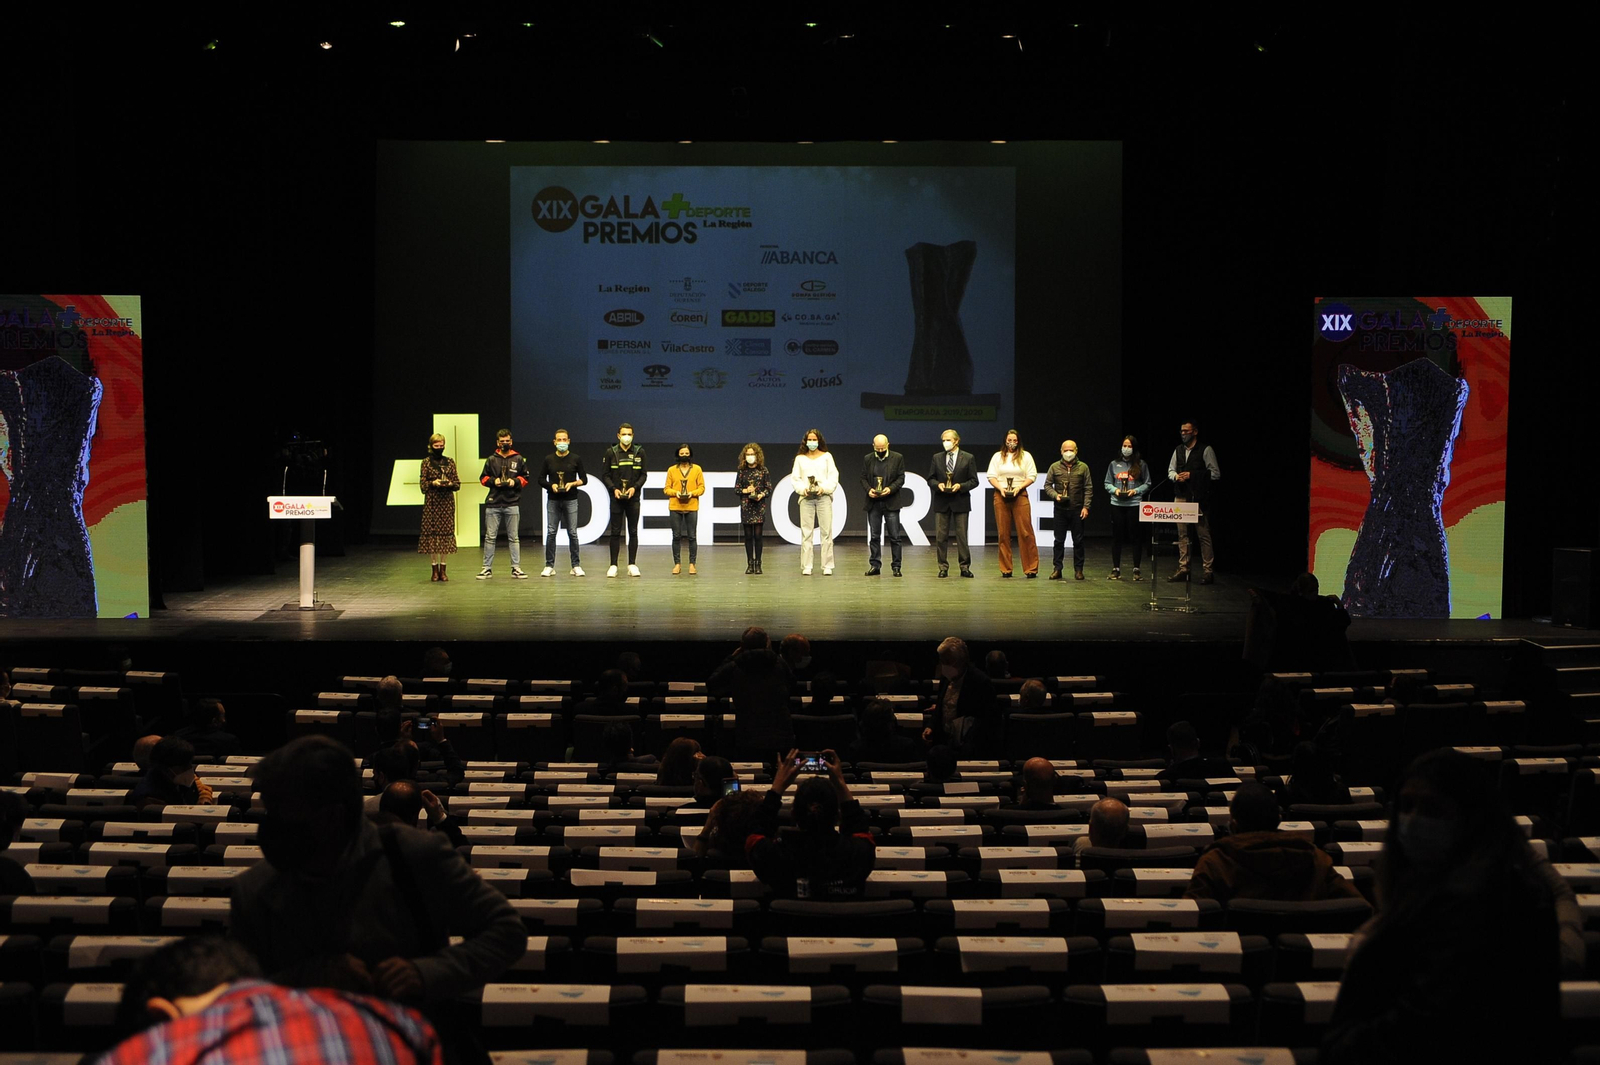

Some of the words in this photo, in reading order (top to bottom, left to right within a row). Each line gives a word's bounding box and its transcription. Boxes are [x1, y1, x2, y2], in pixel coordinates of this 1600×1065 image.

[537, 200, 573, 219] XIX
[580, 195, 661, 219] GALA
[687, 207, 751, 218] DEPORTE
[703, 220, 716, 228] La
[583, 222, 697, 244] PREMIOS
[599, 284, 612, 293] La
[608, 313, 640, 323] ABRIL
[725, 311, 774, 324] GADIS
[1321, 314, 1353, 331] XIX
[1358, 310, 1428, 331] GALA
[1448, 319, 1503, 328] DEPORTE
[78, 318, 133, 328] DEPORTE
[610, 340, 651, 349] PERSAN
[1358, 332, 1458, 351] PREMIOS
[661, 343, 715, 353] VilaCastro
